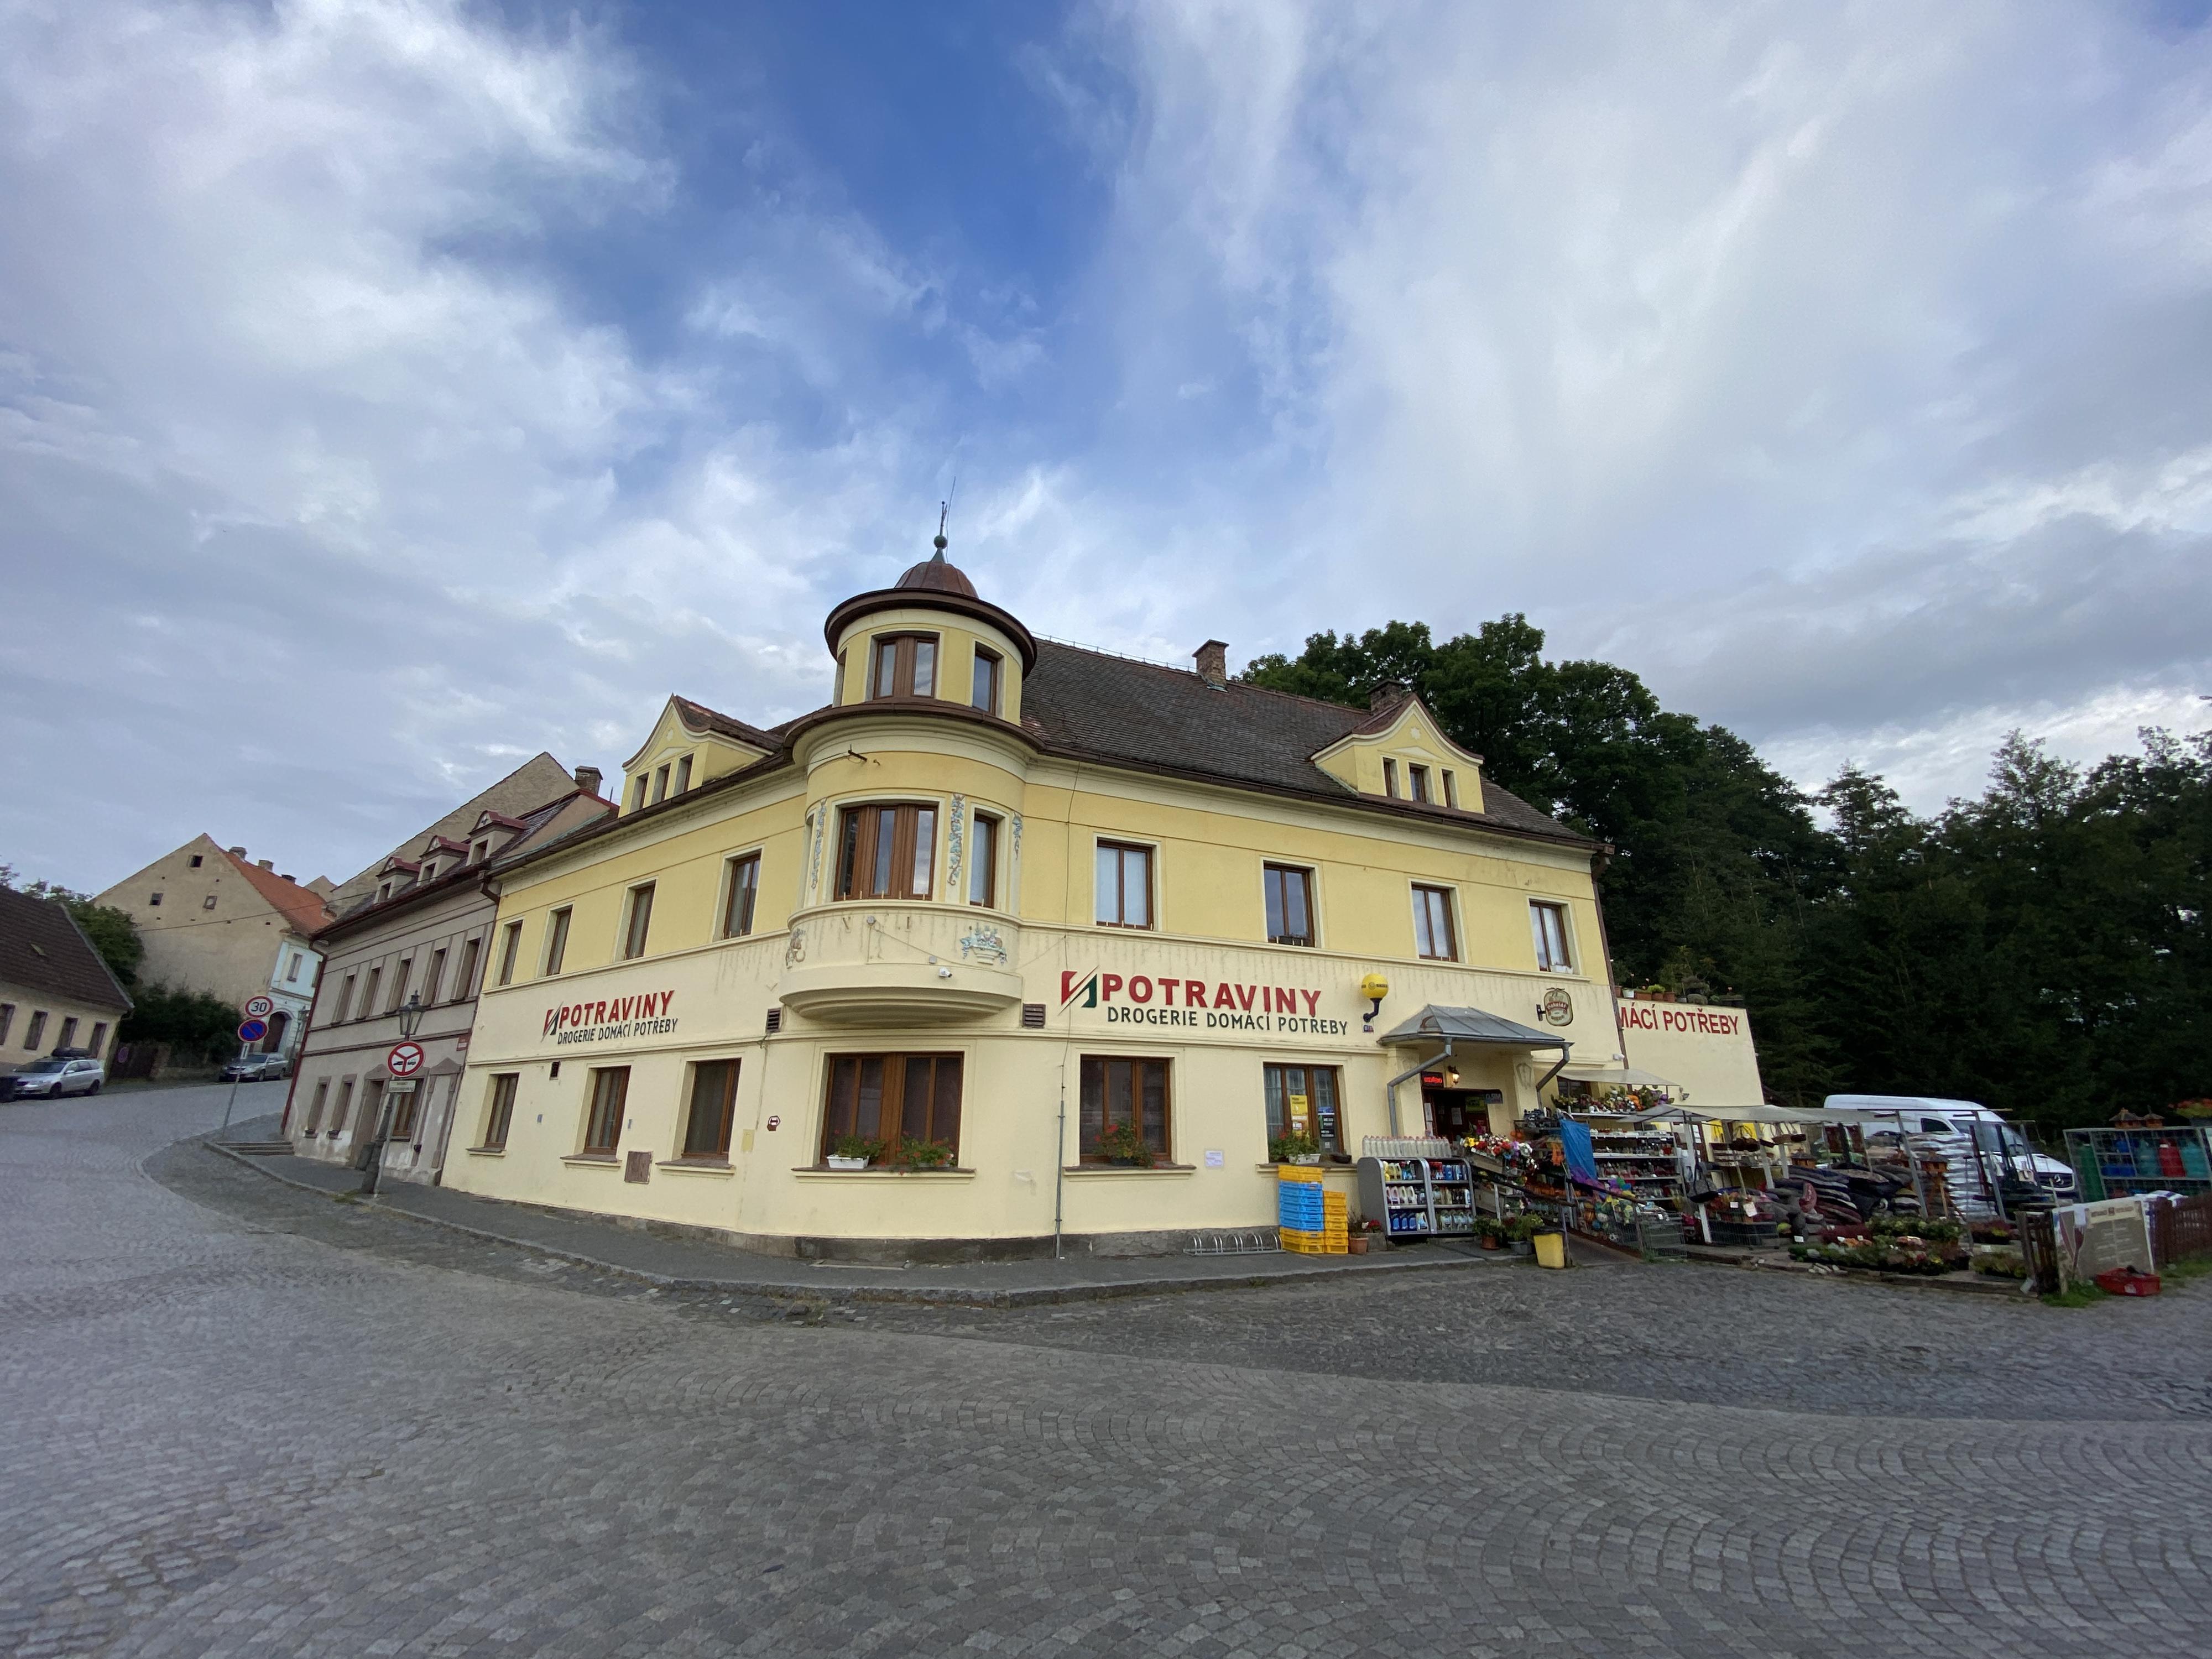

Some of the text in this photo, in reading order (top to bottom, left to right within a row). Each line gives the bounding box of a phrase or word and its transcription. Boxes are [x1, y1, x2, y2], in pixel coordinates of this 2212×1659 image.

[251, 1001, 267, 1012] 30
[1102, 973, 1321, 1016] POTRAVINY
[559, 990, 675, 1029] POTRAVINY
[1108, 1006, 1198, 1026] DROGERIE
[1207, 1009, 1271, 1030] DOMÁCÍ
[1662, 1008, 1739, 1035] POTŘEBY
[557, 1016, 679, 1045] DROGERIE DOMÁCÍ POTŘEBY
